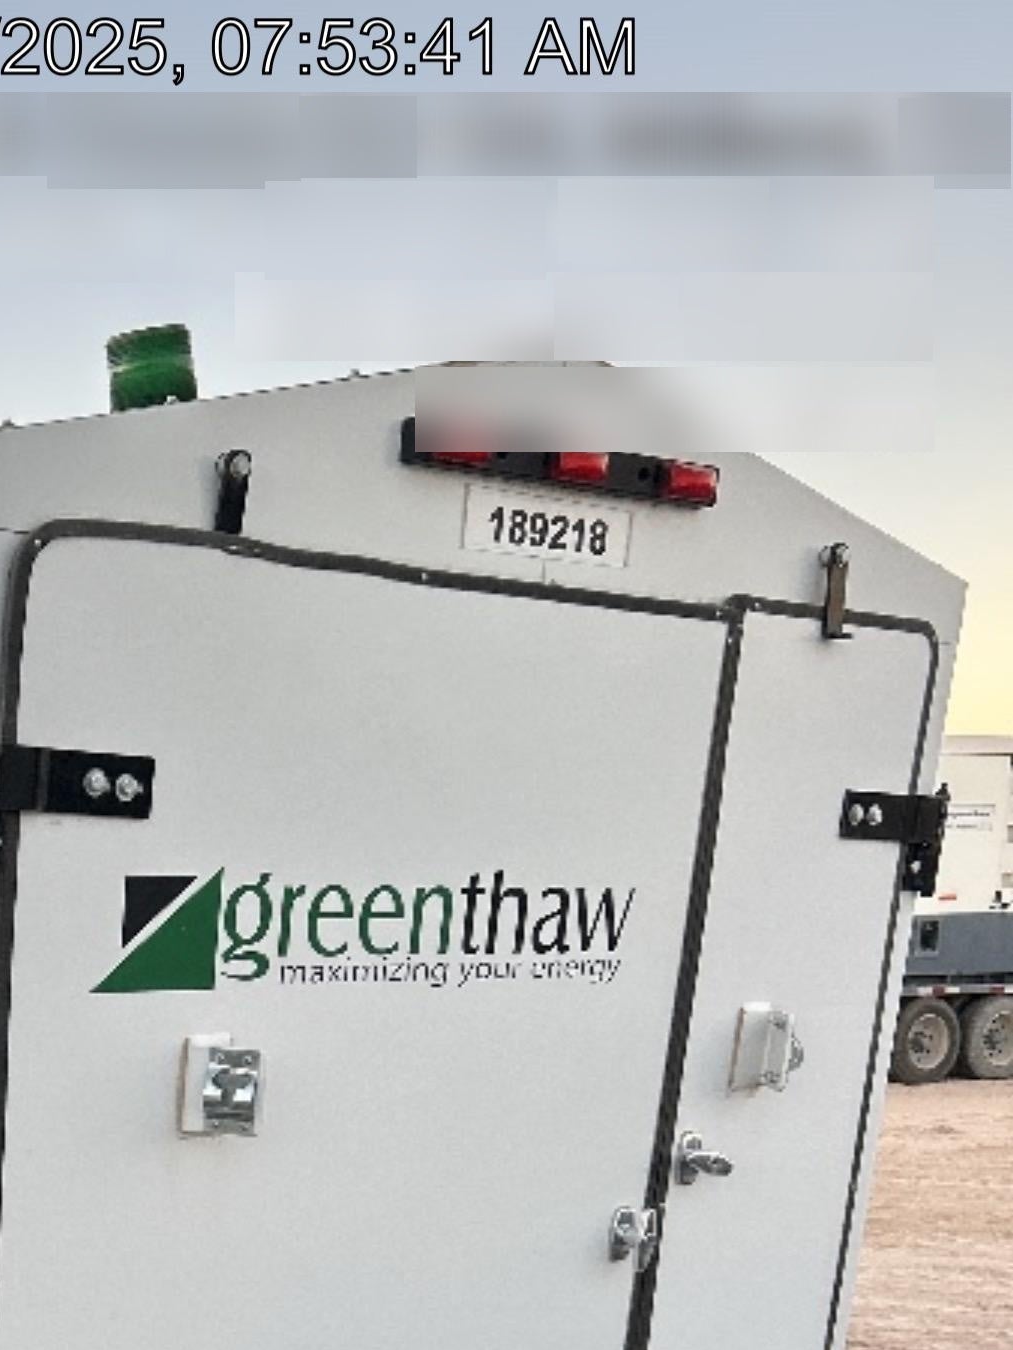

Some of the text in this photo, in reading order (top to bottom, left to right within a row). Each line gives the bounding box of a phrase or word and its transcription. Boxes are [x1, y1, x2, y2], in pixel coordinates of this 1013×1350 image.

[488, 506, 609, 555] 189218
[220, 869, 637, 982] greenthaw
[279, 957, 622, 987] maximizing your energy
